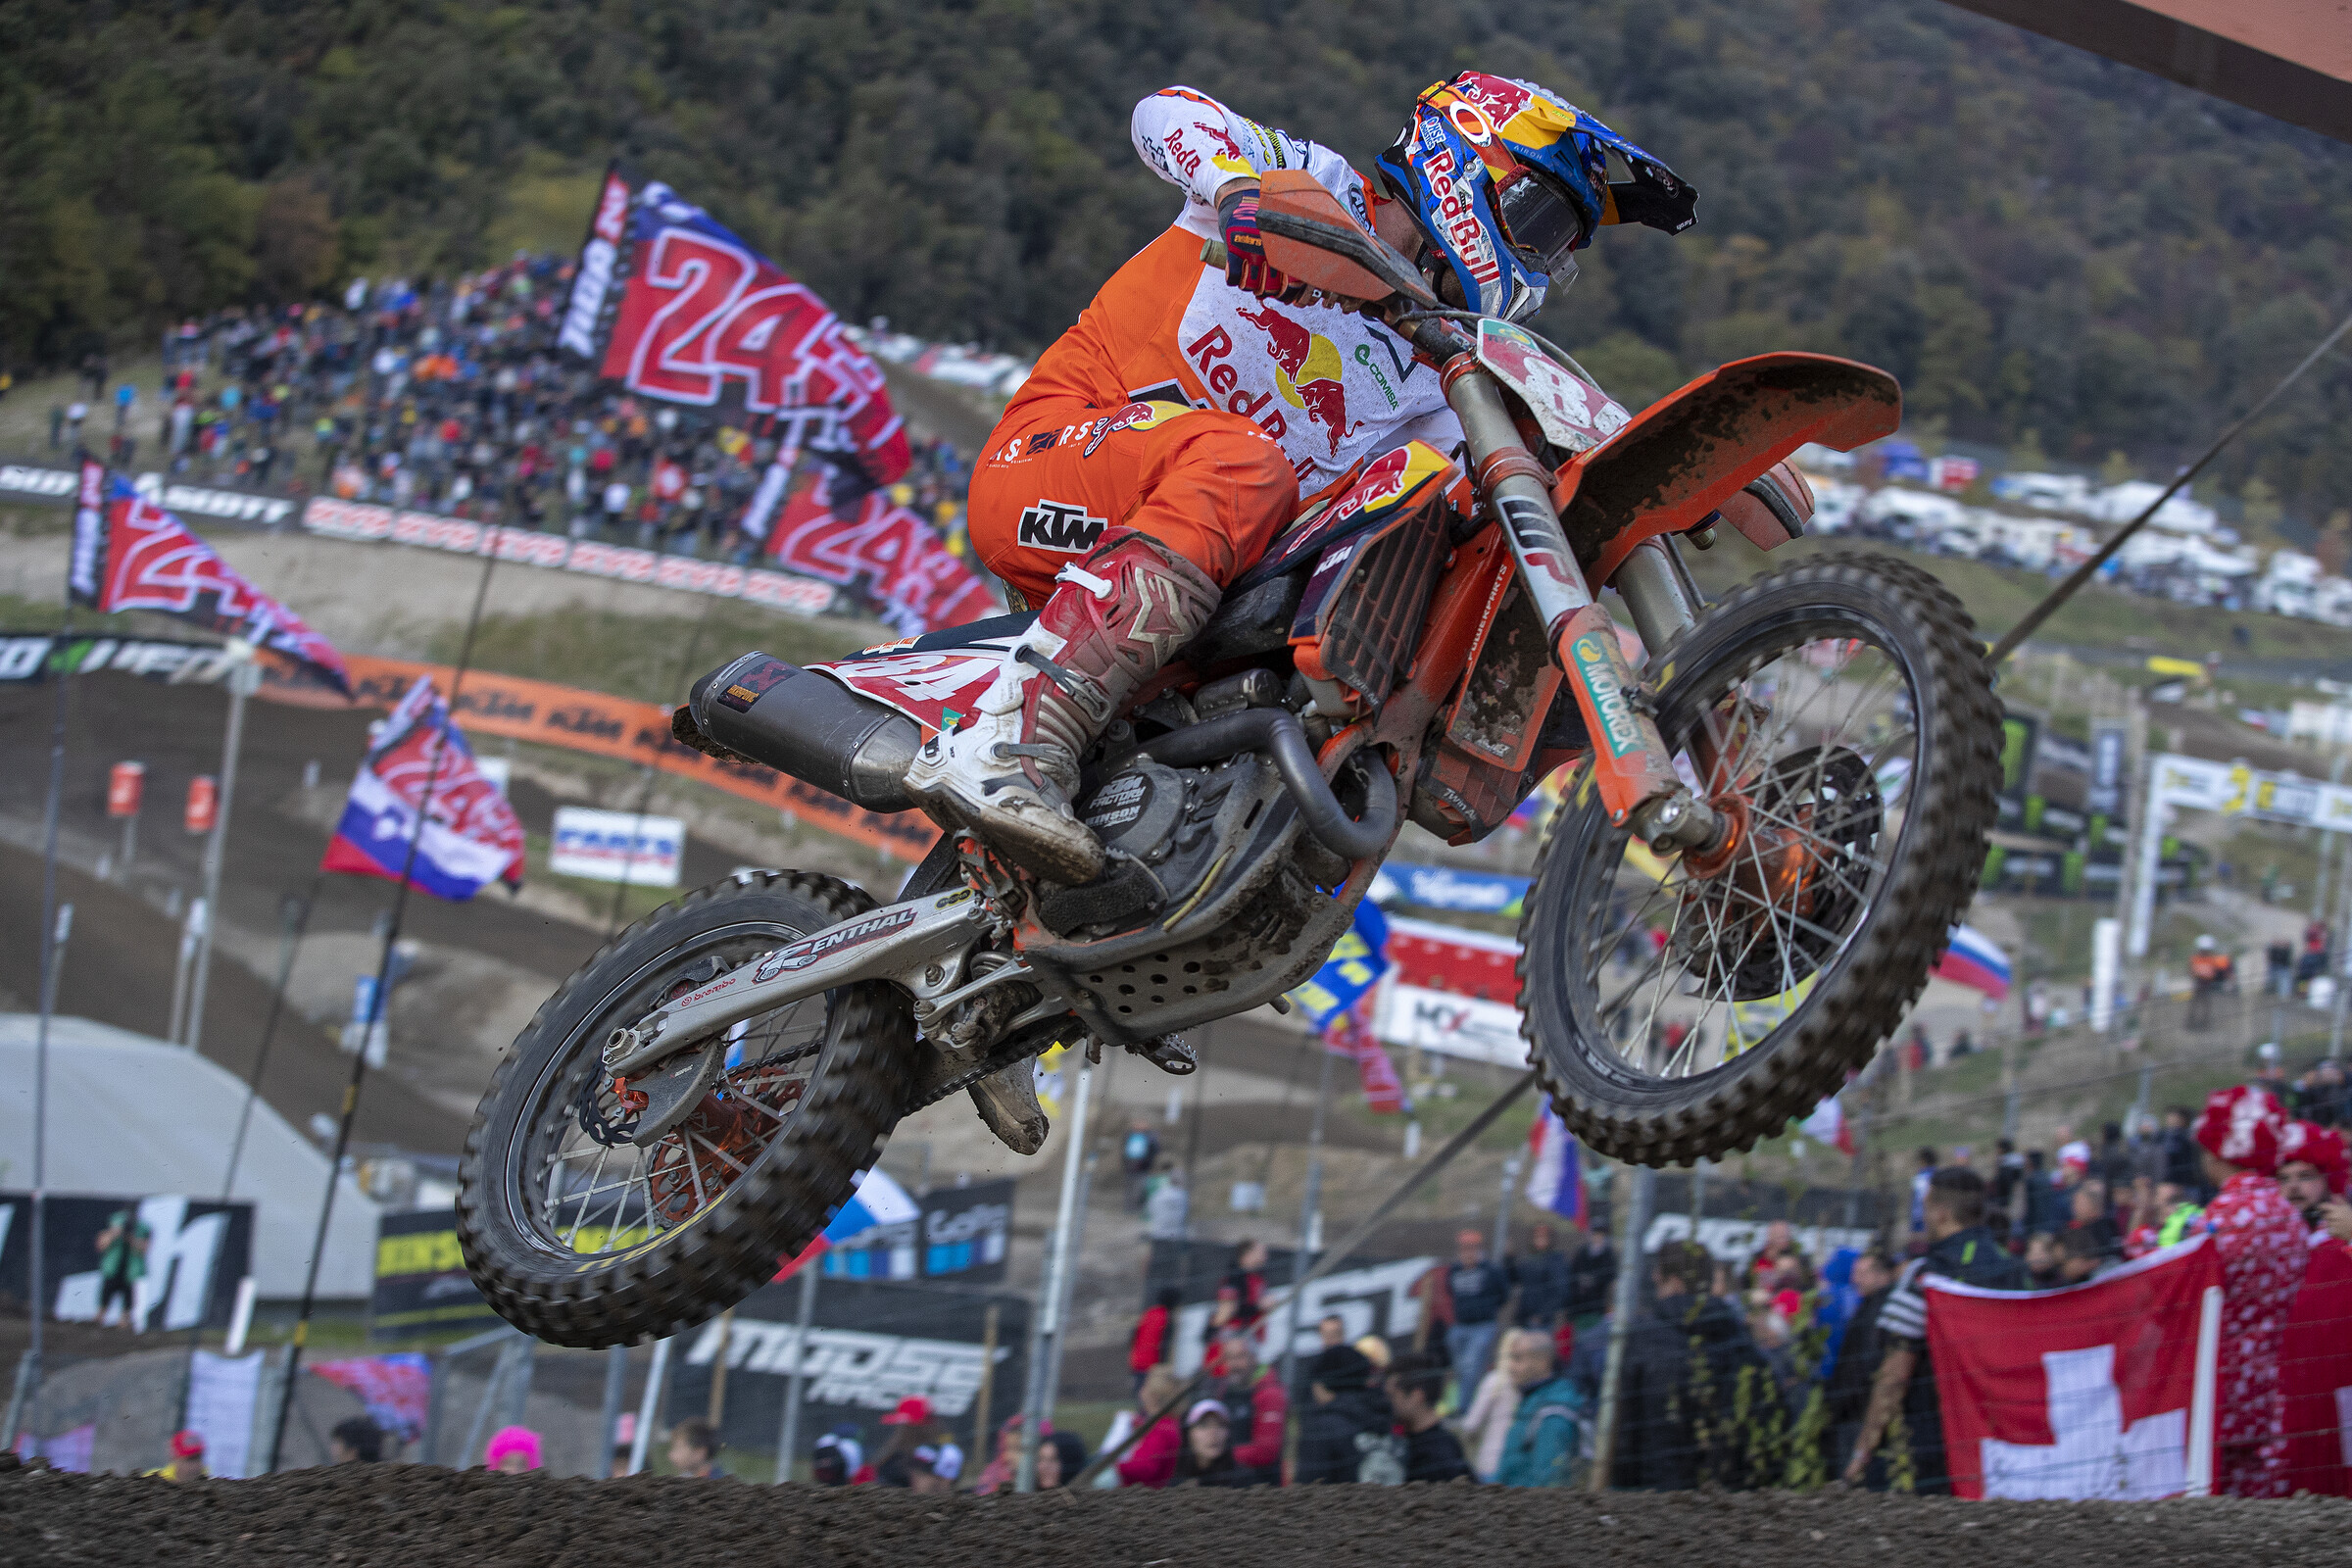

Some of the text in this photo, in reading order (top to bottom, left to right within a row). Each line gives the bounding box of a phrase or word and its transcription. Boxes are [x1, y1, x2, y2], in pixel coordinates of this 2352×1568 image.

[1163, 128, 1196, 167] Red
[1513, 145, 1543, 160] AIROH
[1449, 217, 1500, 285] Bull
[1186, 323, 1318, 482] Red Bll
[1369, 363, 1398, 411] COMISA
[1020, 504, 1105, 550] KTM
[1313, 545, 1353, 577] KTM
[1584, 662, 1639, 753] MOTOREX
[1089, 786, 1147, 809] FACTORY
[1098, 775, 1145, 798] KTM
[1442, 788, 1467, 813] Twin
[1085, 806, 1142, 826] HINSON
[757, 908, 915, 981] RENTHAL
[694, 978, 737, 1001] brembo
[687, 1316, 1010, 1380] MOOSE
